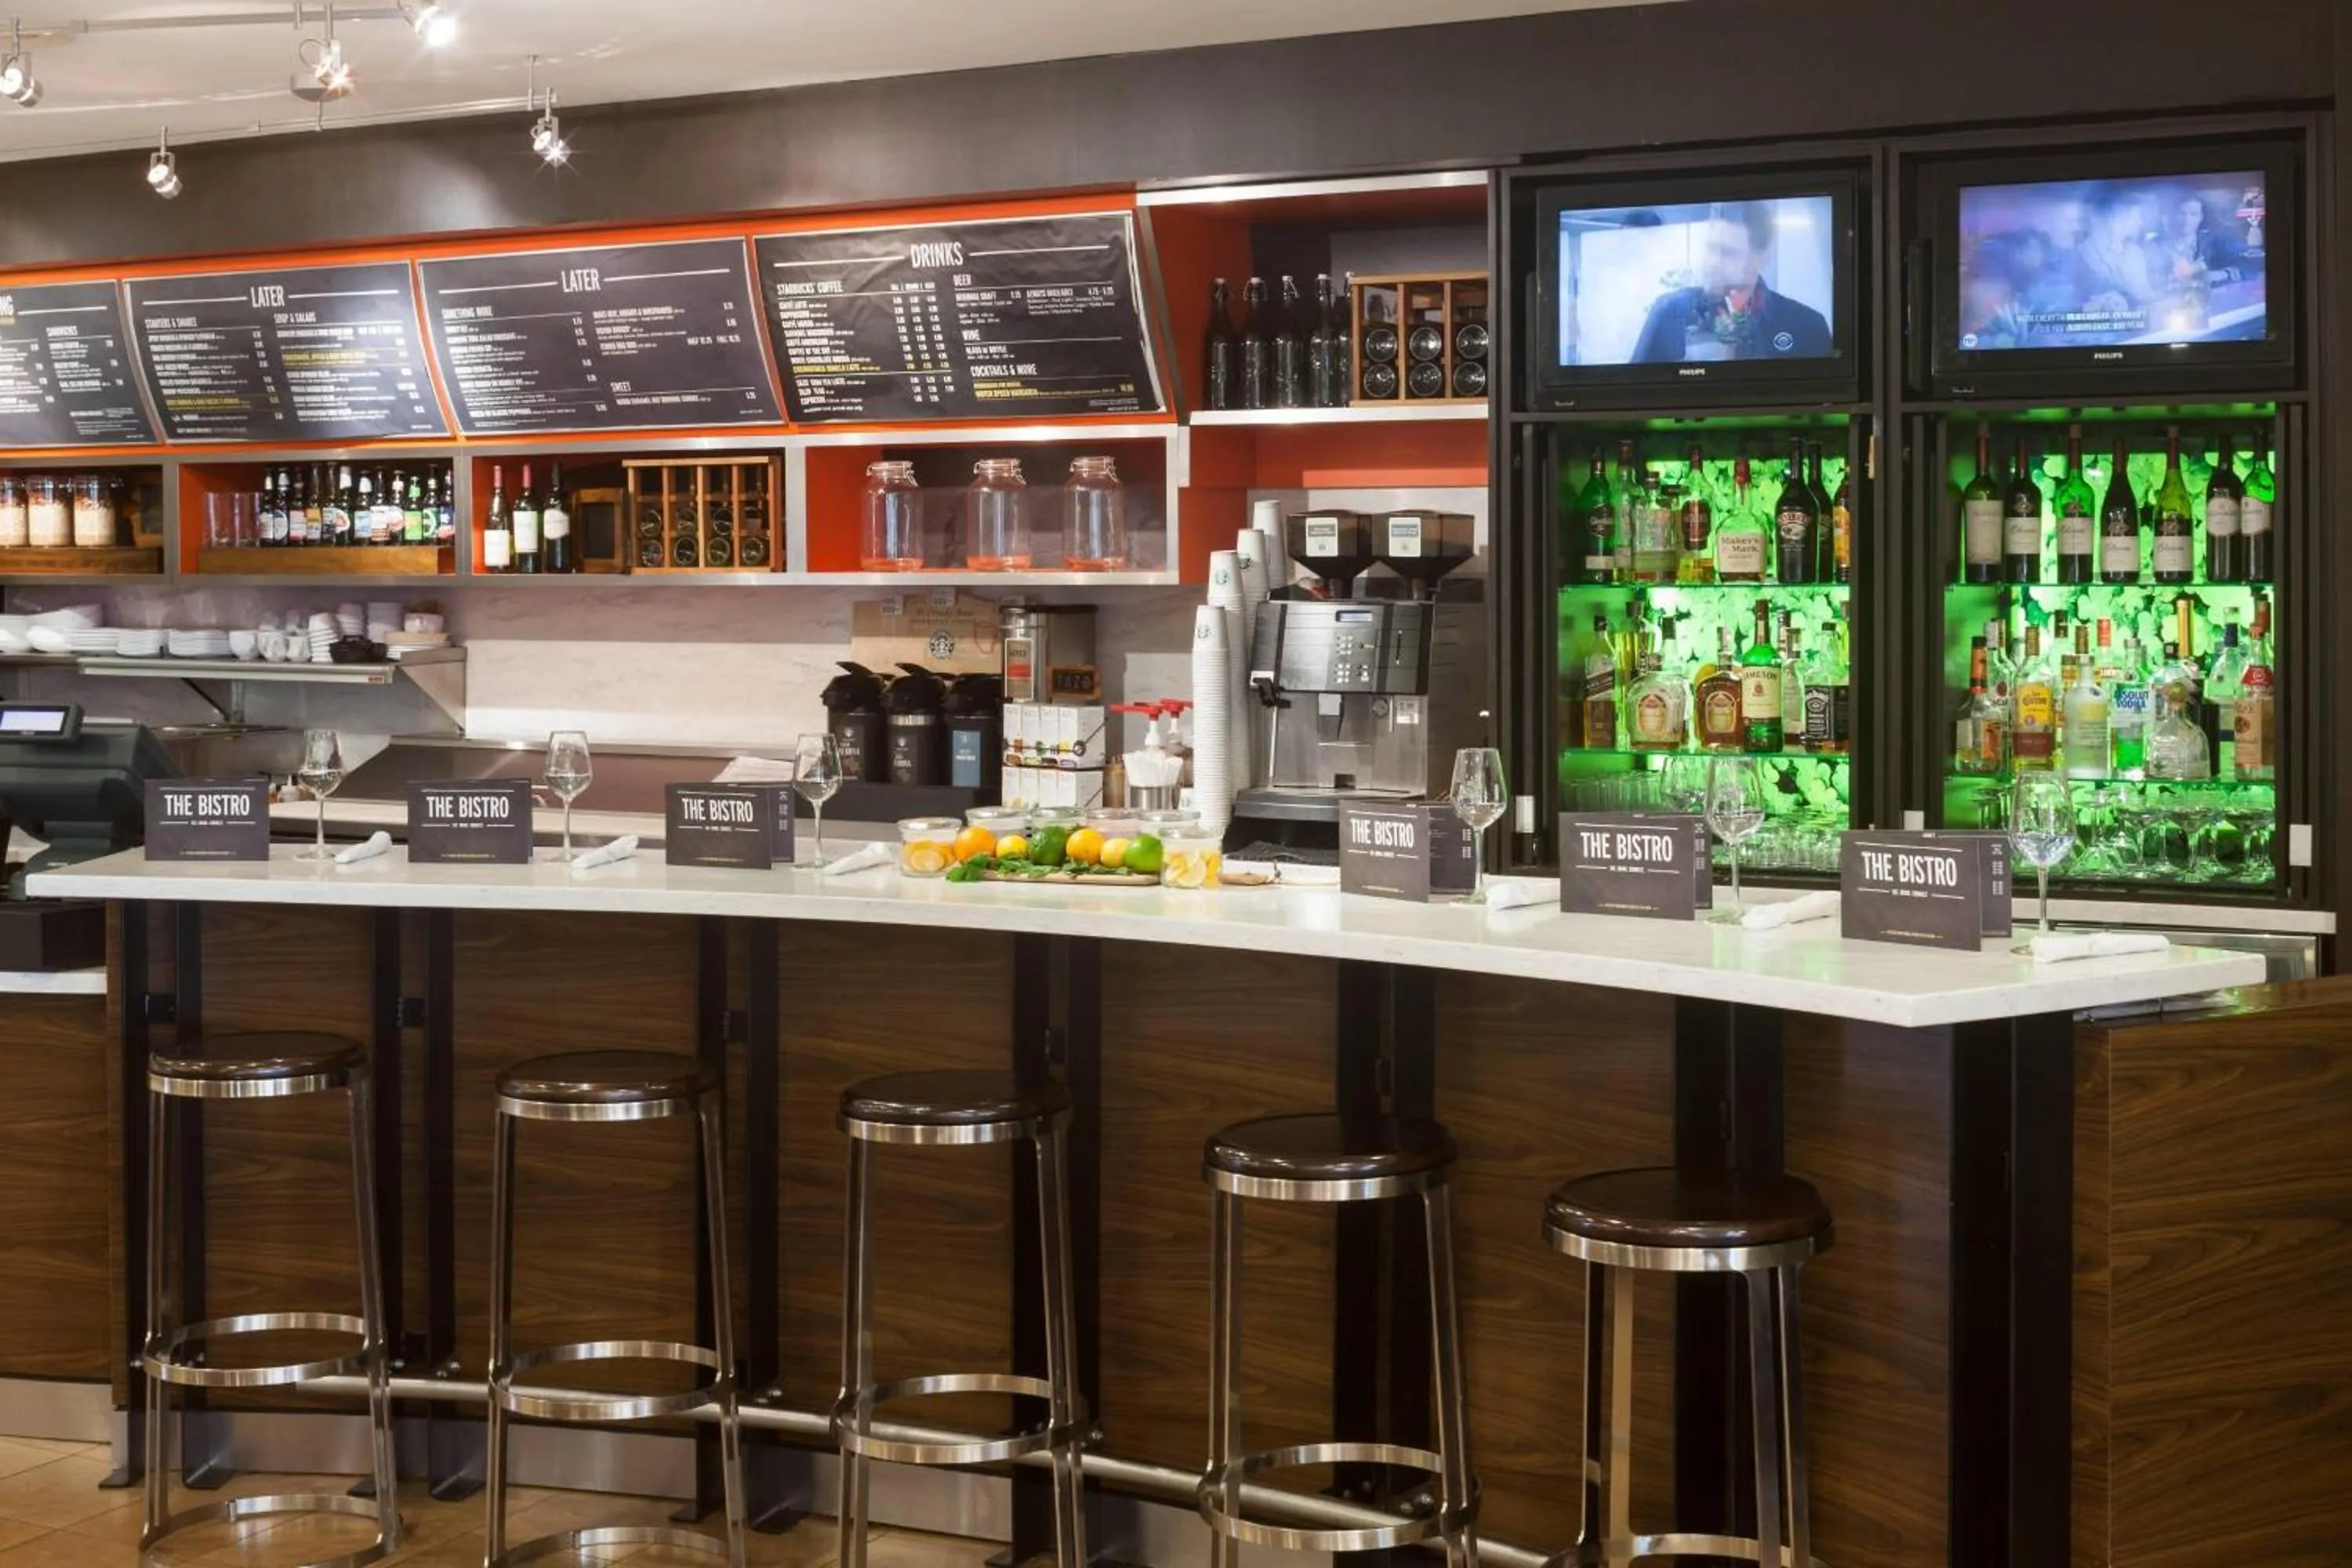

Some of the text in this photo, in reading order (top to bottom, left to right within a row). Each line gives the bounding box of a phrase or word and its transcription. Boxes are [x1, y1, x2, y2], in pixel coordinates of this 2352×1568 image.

[910, 241, 964, 268] DRINKS
[561, 268, 601, 292] LATER
[250, 284, 285, 307] LATER
[970, 365, 1009, 377] COCKTAILS
[164, 793, 251, 816] THE BISTRO
[426, 796, 510, 818] THE BISTRO
[681, 797, 754, 822] THE BISTRO
[1349, 818, 1414, 848] THE BISTRO
[1580, 831, 1673, 862] THE BISTRO
[1860, 851, 1958, 887] THE BISTRO
